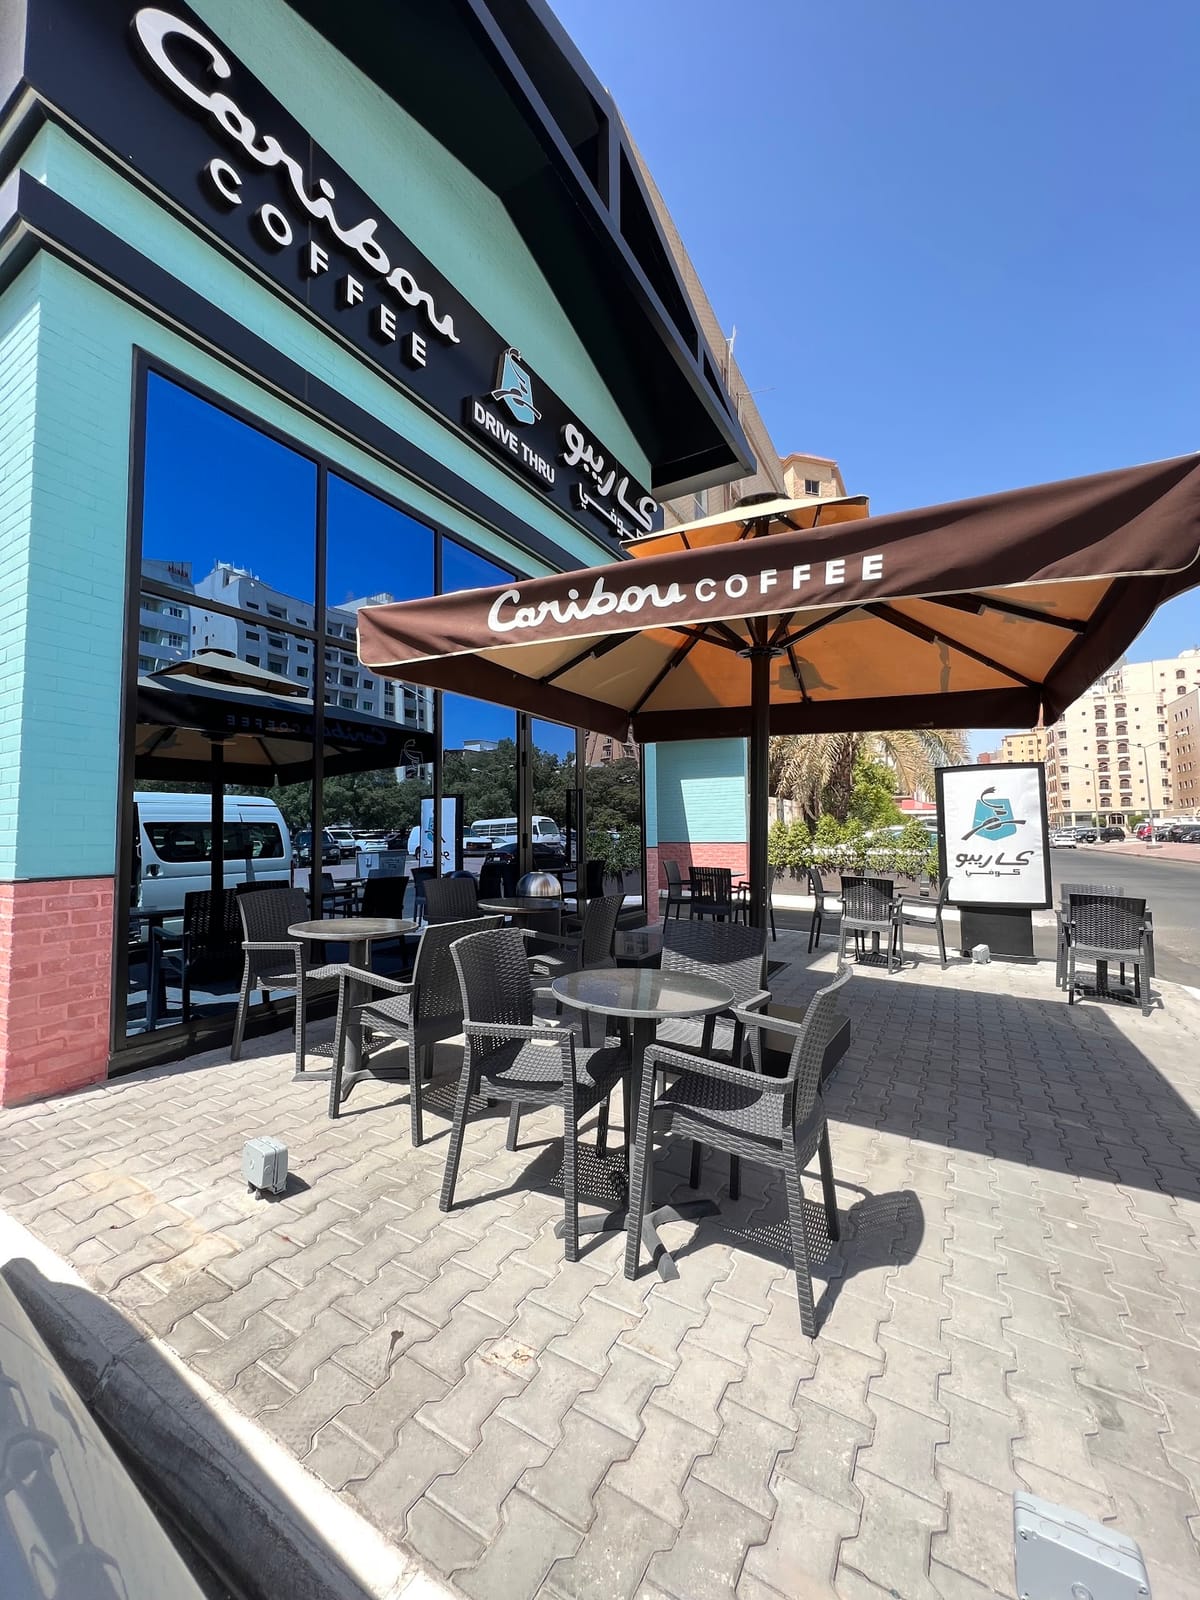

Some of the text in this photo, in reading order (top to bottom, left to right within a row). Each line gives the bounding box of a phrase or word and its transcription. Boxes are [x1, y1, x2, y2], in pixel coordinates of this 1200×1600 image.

[134, 7, 461, 344] Caribou
[207, 157, 427, 367] COFFEE
[474, 400, 556, 484] DRIVE THRU
[563, 422, 658, 532] كاريبو
[486, 553, 884, 633] Caribou COFFEE
[955, 850, 1035, 868] كاريبو
